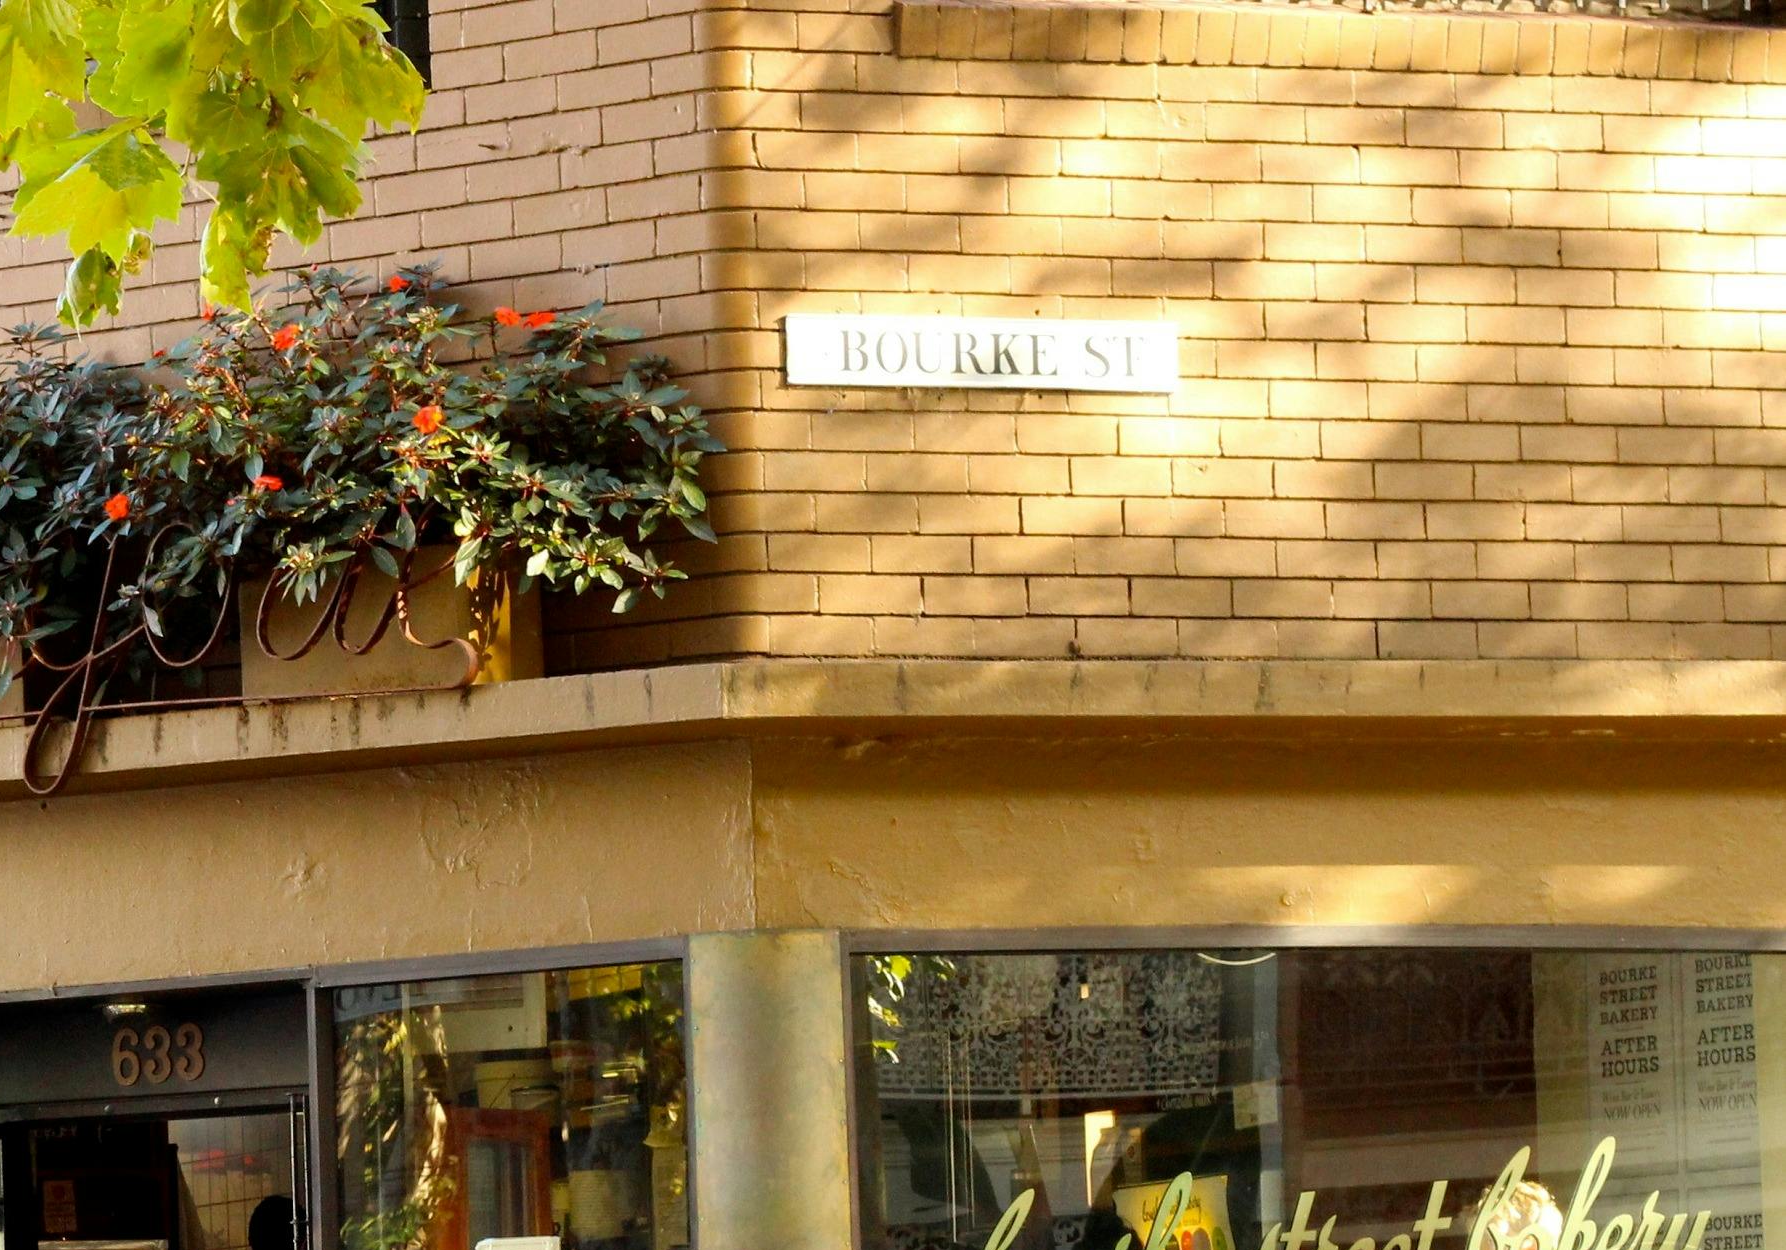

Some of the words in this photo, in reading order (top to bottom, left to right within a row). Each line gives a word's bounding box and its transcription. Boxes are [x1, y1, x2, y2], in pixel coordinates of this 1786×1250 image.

[840, 328, 1058, 377] BOURKE
[1083, 334, 1148, 379] ST
[1694, 953, 1752, 974] BOURKE
[1598, 965, 1657, 986] BOURKE
[1695, 972, 1753, 994] STREET
[1599, 985, 1657, 1005] STREET
[1696, 994, 1754, 1014] BAKERY
[1600, 1005, 1658, 1026] BAKERY
[1697, 1023, 1755, 1045] AFTER
[112, 1022, 205, 1086] 633
[1600, 1034, 1658, 1057] AFTER
[1697, 1045, 1756, 1067] HOURS
[1601, 1056, 1660, 1078] HOURS
[1705, 1214, 1763, 1232] BOURKE
[1704, 1234, 1763, 1250] STREET
